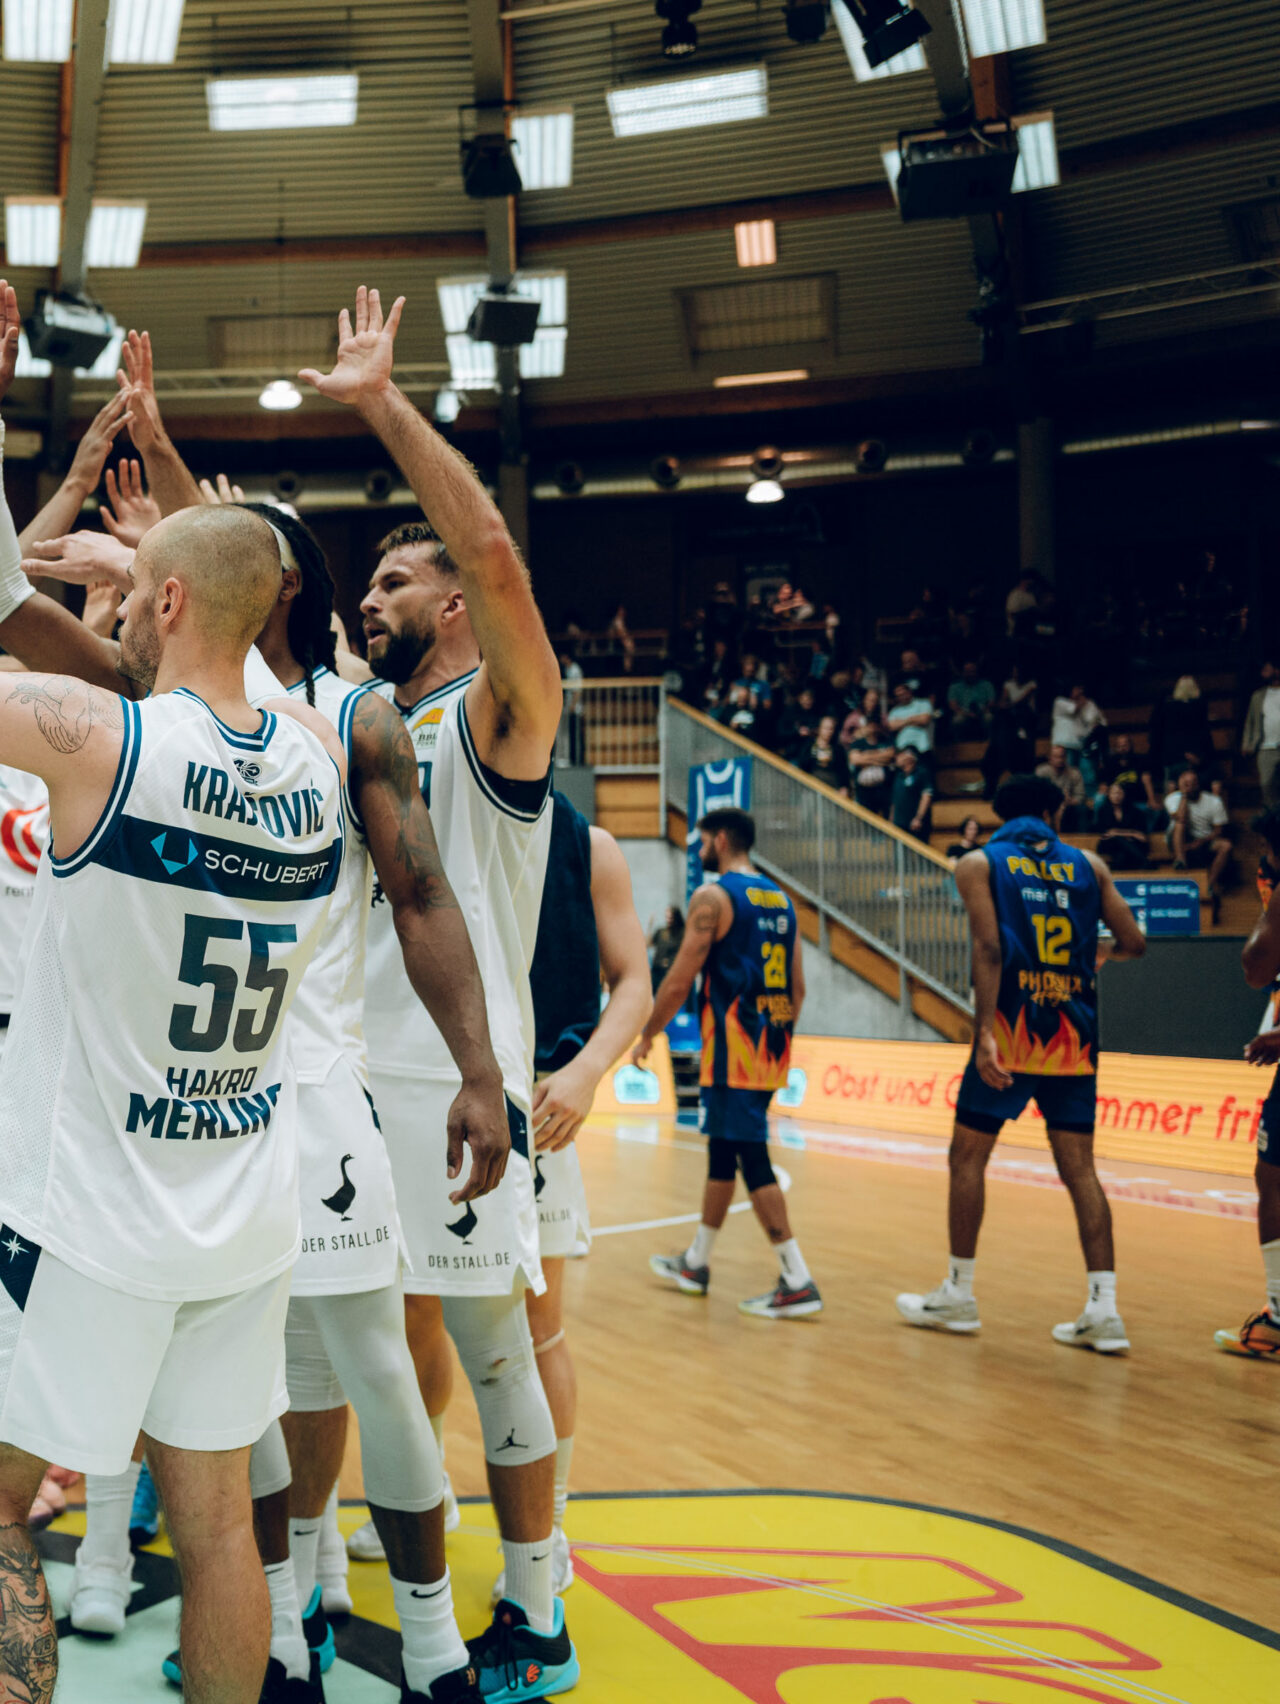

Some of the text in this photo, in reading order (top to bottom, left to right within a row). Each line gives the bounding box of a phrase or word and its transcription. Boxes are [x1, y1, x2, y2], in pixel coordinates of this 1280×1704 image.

[204, 849, 329, 884] SCHUBERT
[1031, 913, 1072, 967] 12
[168, 912, 298, 1053] 55
[166, 1066, 258, 1098] HAKRO
[823, 1065, 878, 1099] Obst
[886, 1072, 933, 1107] und
[1096, 1097, 1203, 1136] mmer
[302, 1226, 390, 1253] DER STALL.DE
[428, 1252, 510, 1270] DER STALL.DE
